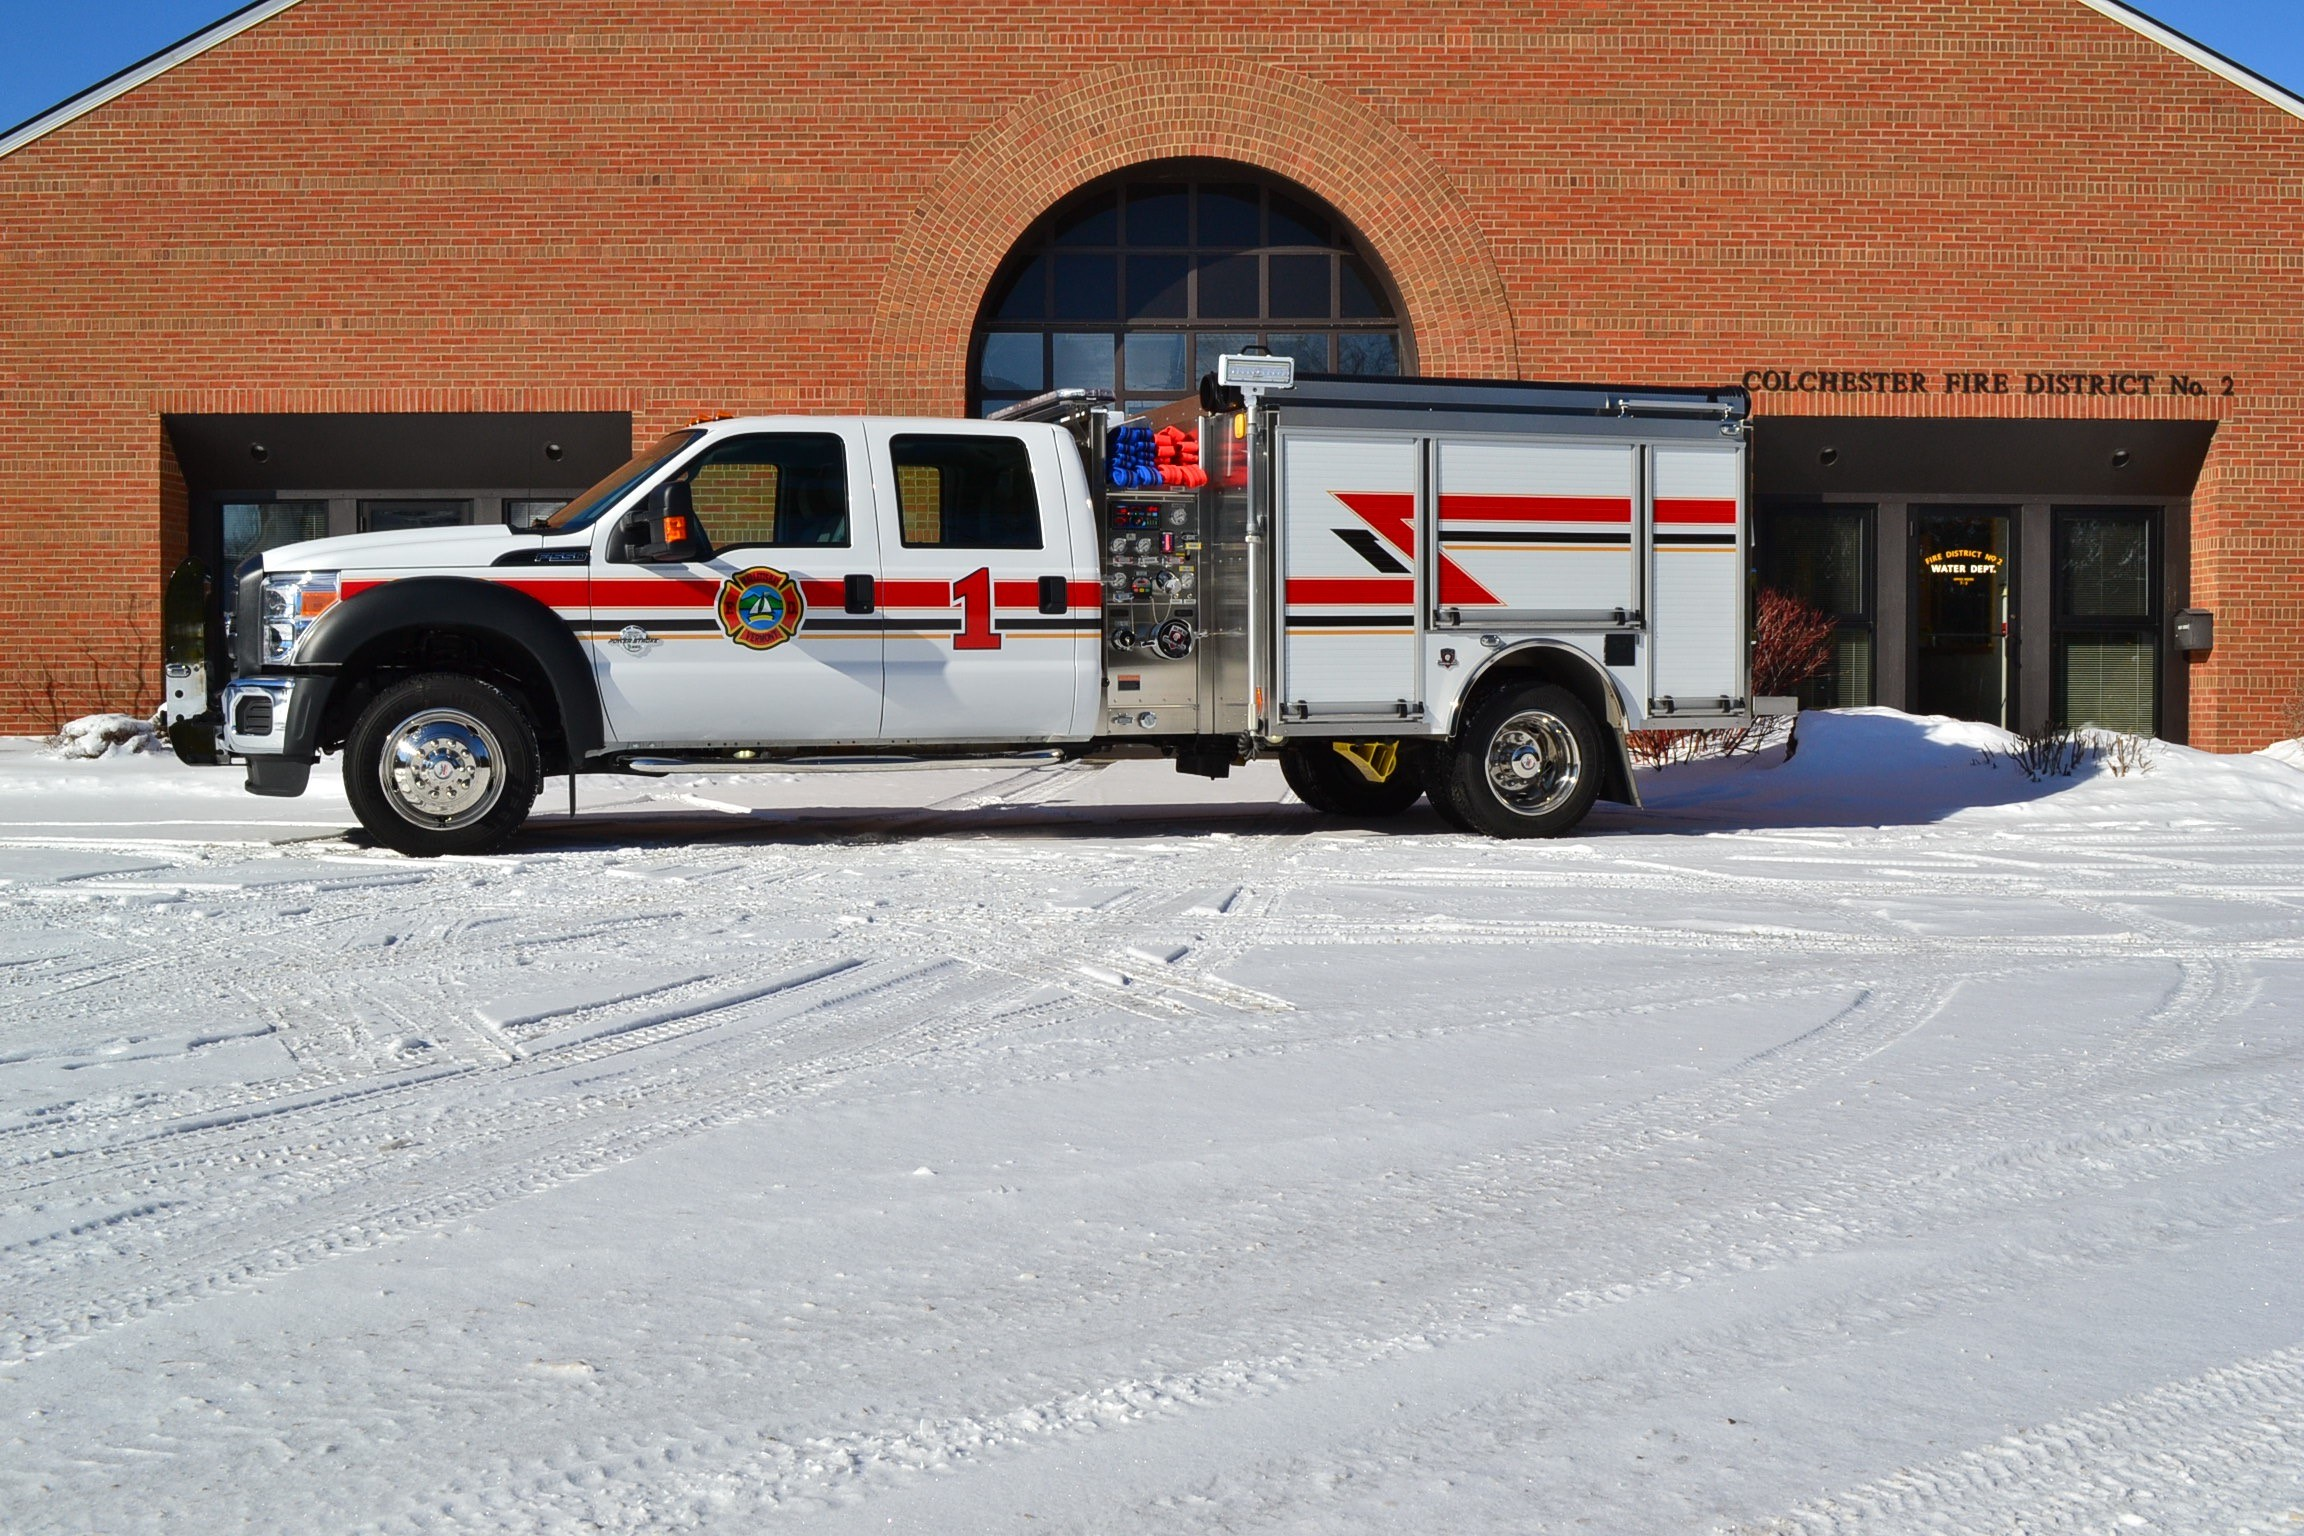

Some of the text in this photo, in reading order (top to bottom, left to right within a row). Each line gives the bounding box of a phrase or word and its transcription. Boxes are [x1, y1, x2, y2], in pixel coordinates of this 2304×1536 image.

[1742, 370, 2235, 397] COLCHESTER FIRE DISTRICT No. 2
[1925, 553, 1943, 565] FIRE
[1945, 549, 1982, 559] DISTRICT
[1930, 564, 1997, 574] WATER DEPT.
[953, 567, 1002, 650] 1
[746, 630, 778, 643] VERMONT
